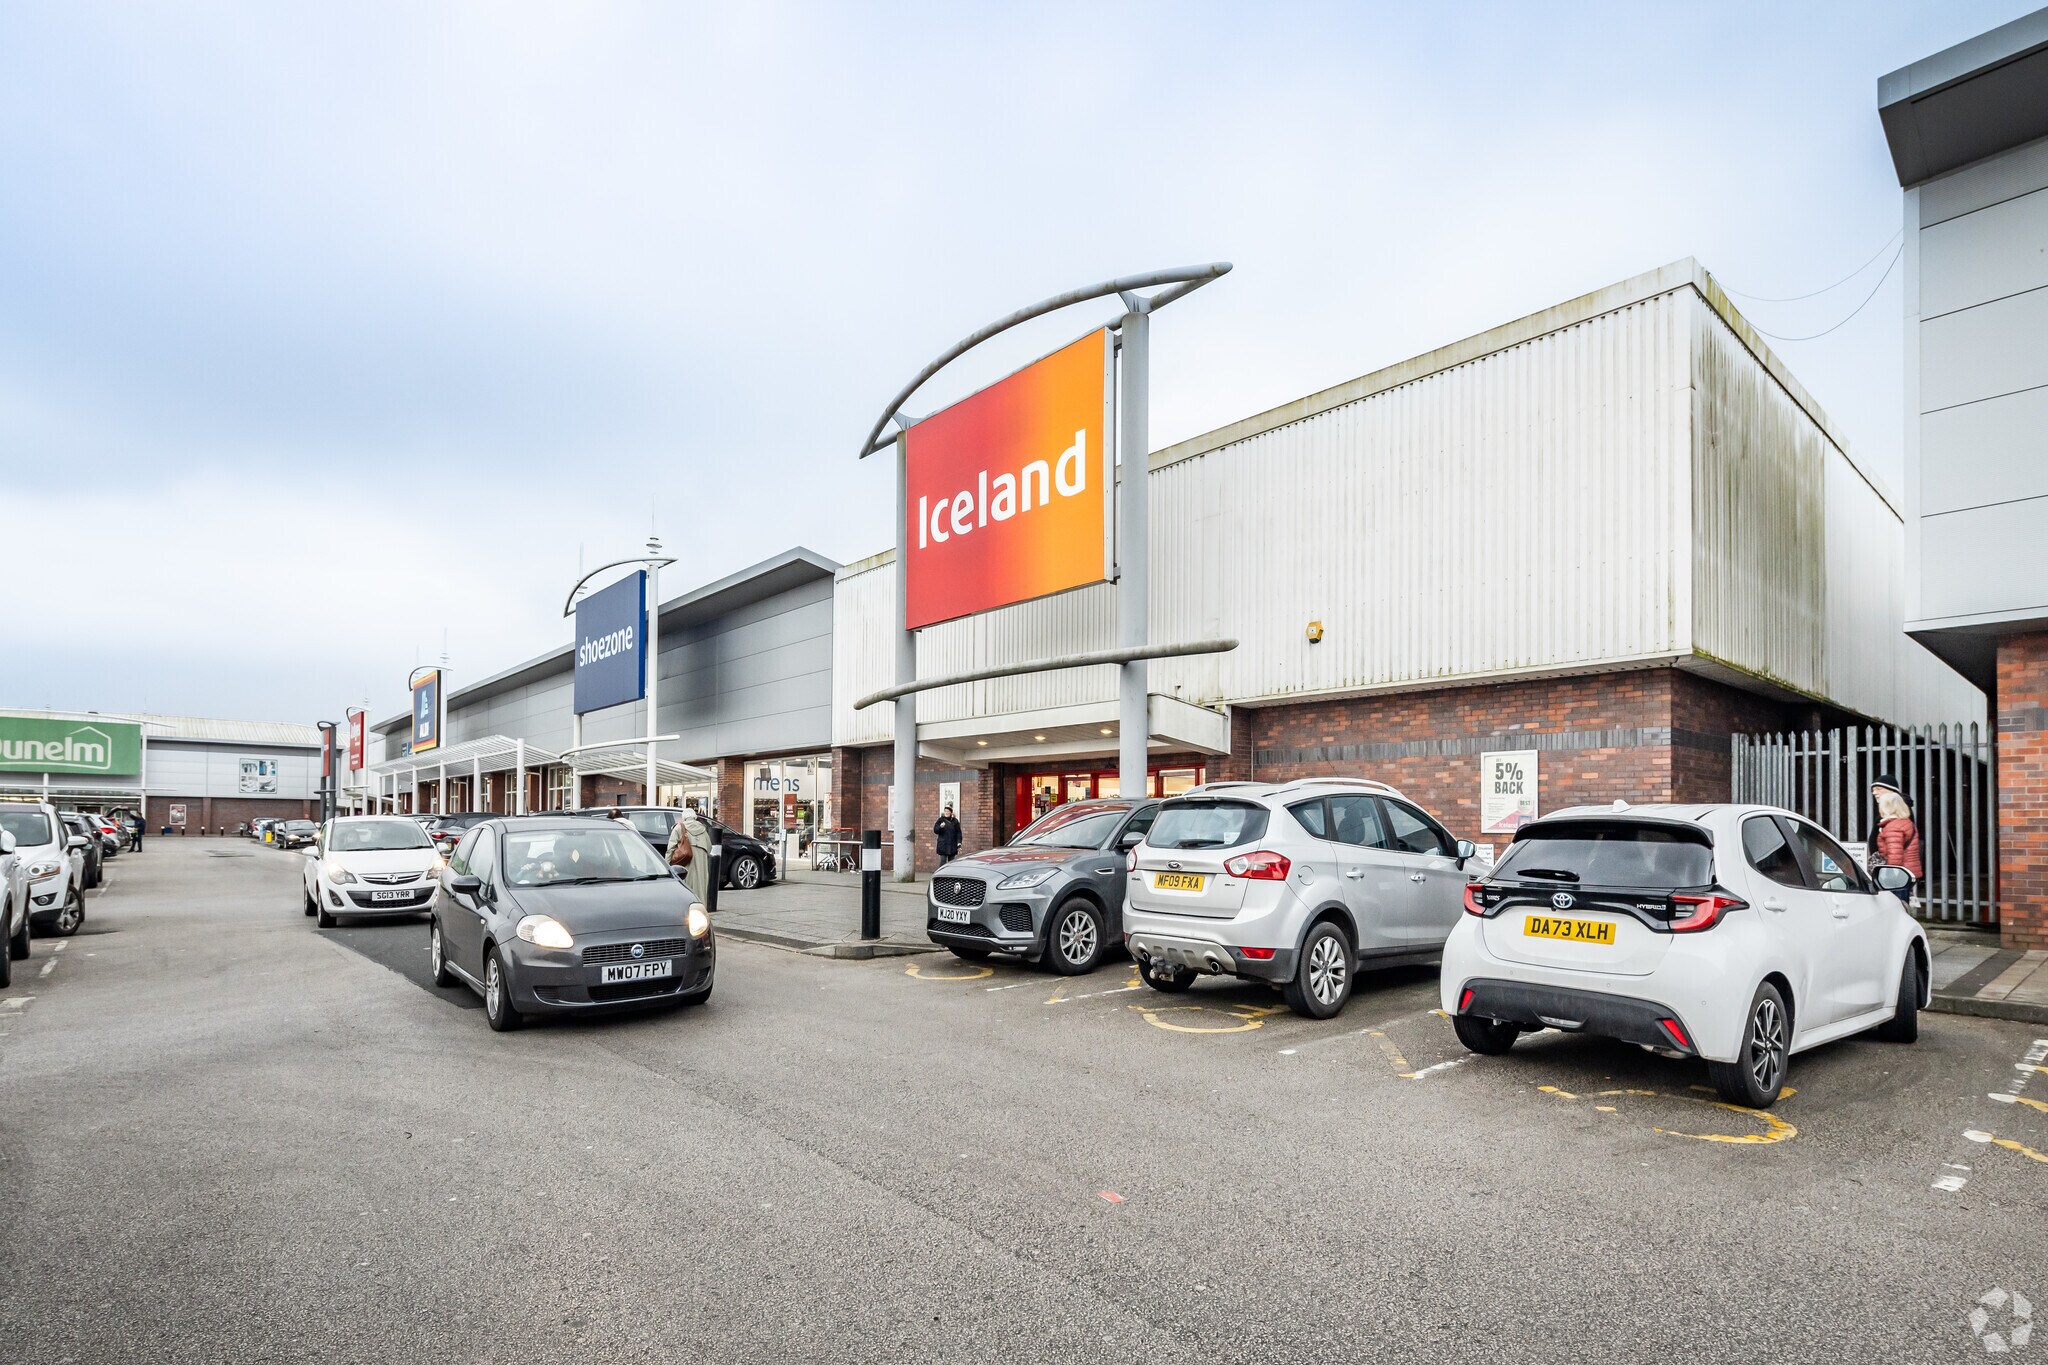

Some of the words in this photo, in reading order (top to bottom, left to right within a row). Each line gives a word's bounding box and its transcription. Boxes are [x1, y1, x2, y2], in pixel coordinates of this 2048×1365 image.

[919, 428, 1086, 550] Iceland
[579, 625, 633, 667] shoezone
[1495, 762, 1523, 780] 5%
[753, 776, 800, 792] mens
[1494, 781, 1524, 794] BACK
[1157, 874, 1180, 887] MF09
[1181, 876, 1199, 889] FXA
[955, 910, 968, 921] YXY
[1530, 918, 1572, 937] DA73
[1575, 922, 1608, 940] XLH
[607, 965, 640, 981] MW07
[644, 961, 667, 977] FPY
